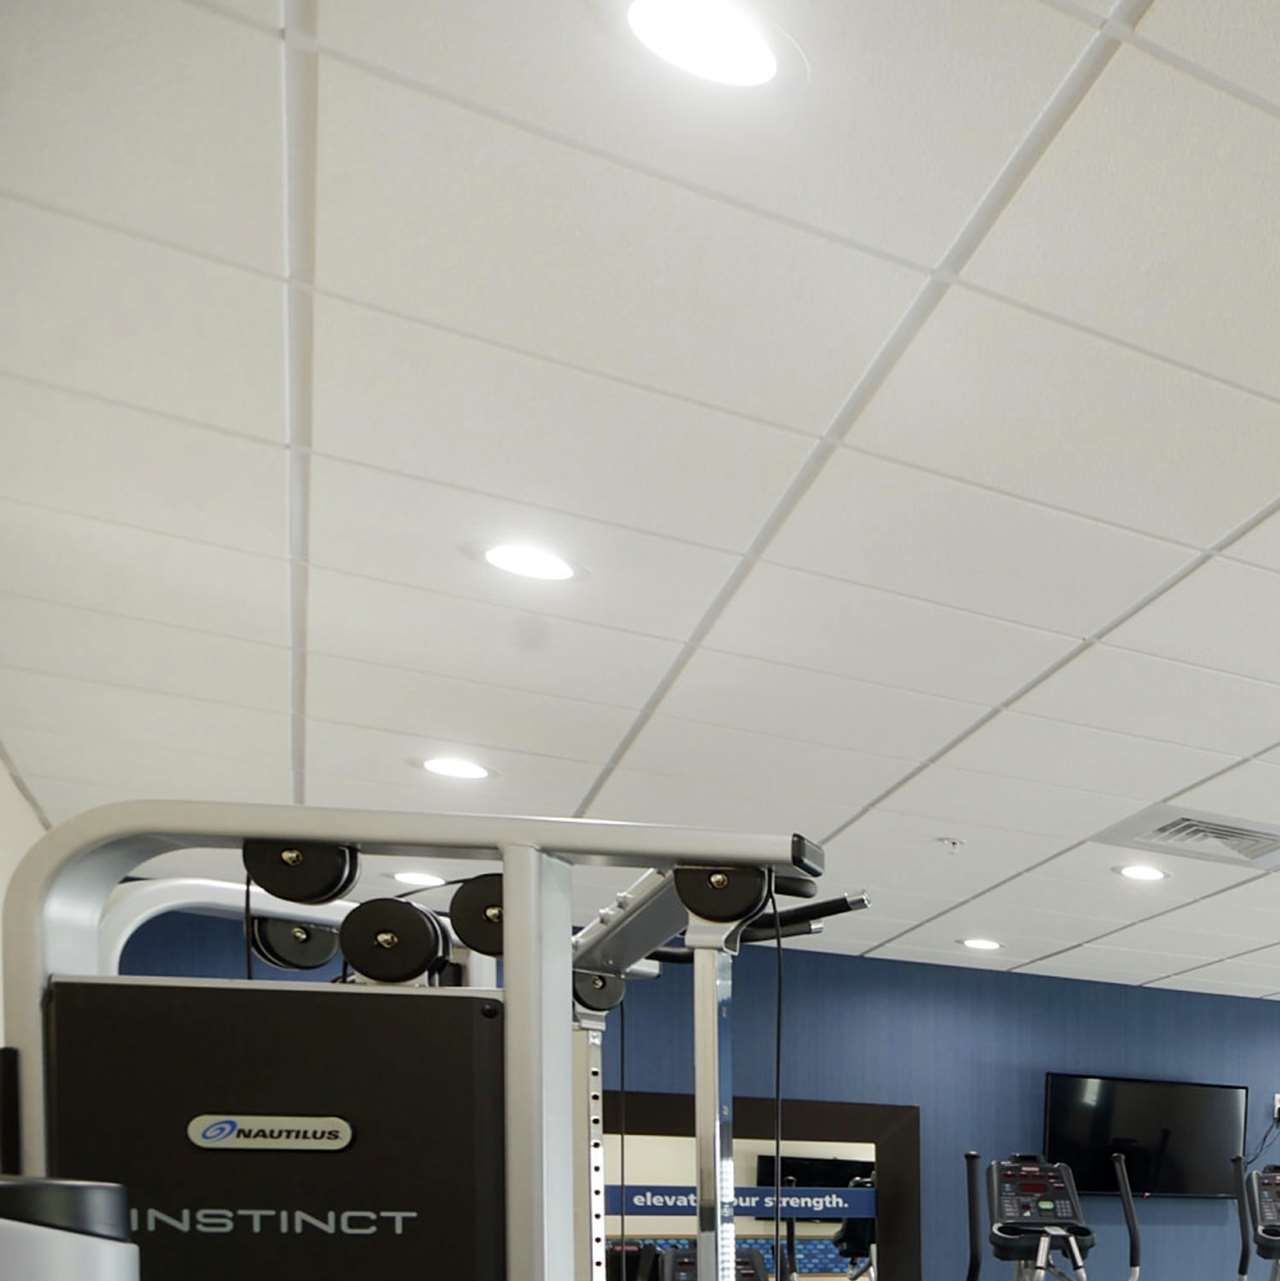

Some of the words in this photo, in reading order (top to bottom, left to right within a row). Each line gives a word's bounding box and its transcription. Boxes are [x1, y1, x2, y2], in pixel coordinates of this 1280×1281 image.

[236, 1129, 340, 1140] NAUTILUS
[633, 1192, 697, 1206] elevat
[130, 1208, 418, 1234] INSTINCT
